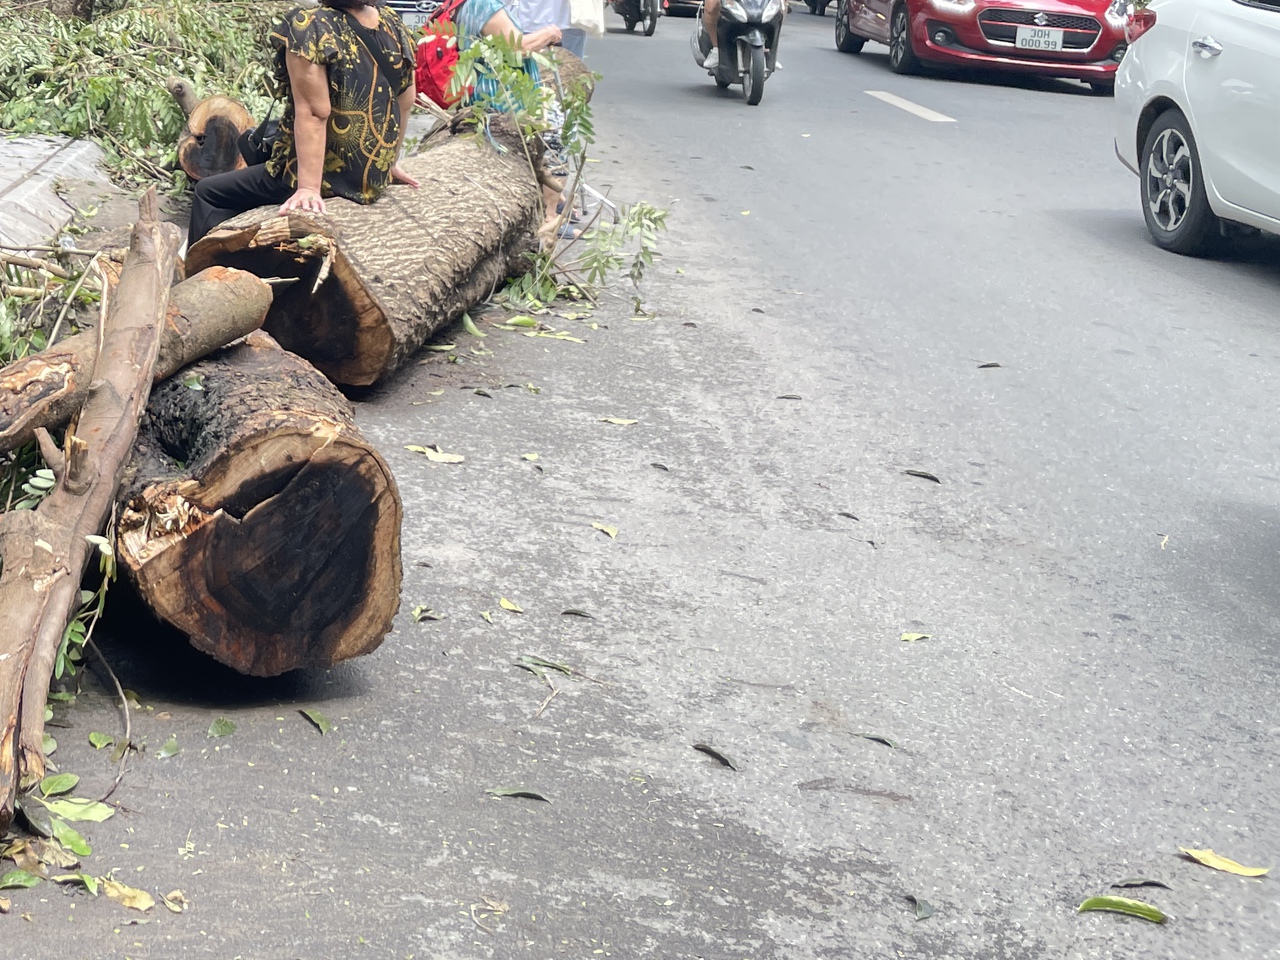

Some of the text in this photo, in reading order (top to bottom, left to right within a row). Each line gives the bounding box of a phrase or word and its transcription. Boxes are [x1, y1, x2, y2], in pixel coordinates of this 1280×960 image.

[415, 15, 430, 24] 30
[1030, 29, 1050, 39] 30H
[1021, 38, 1057, 49] 000.99
